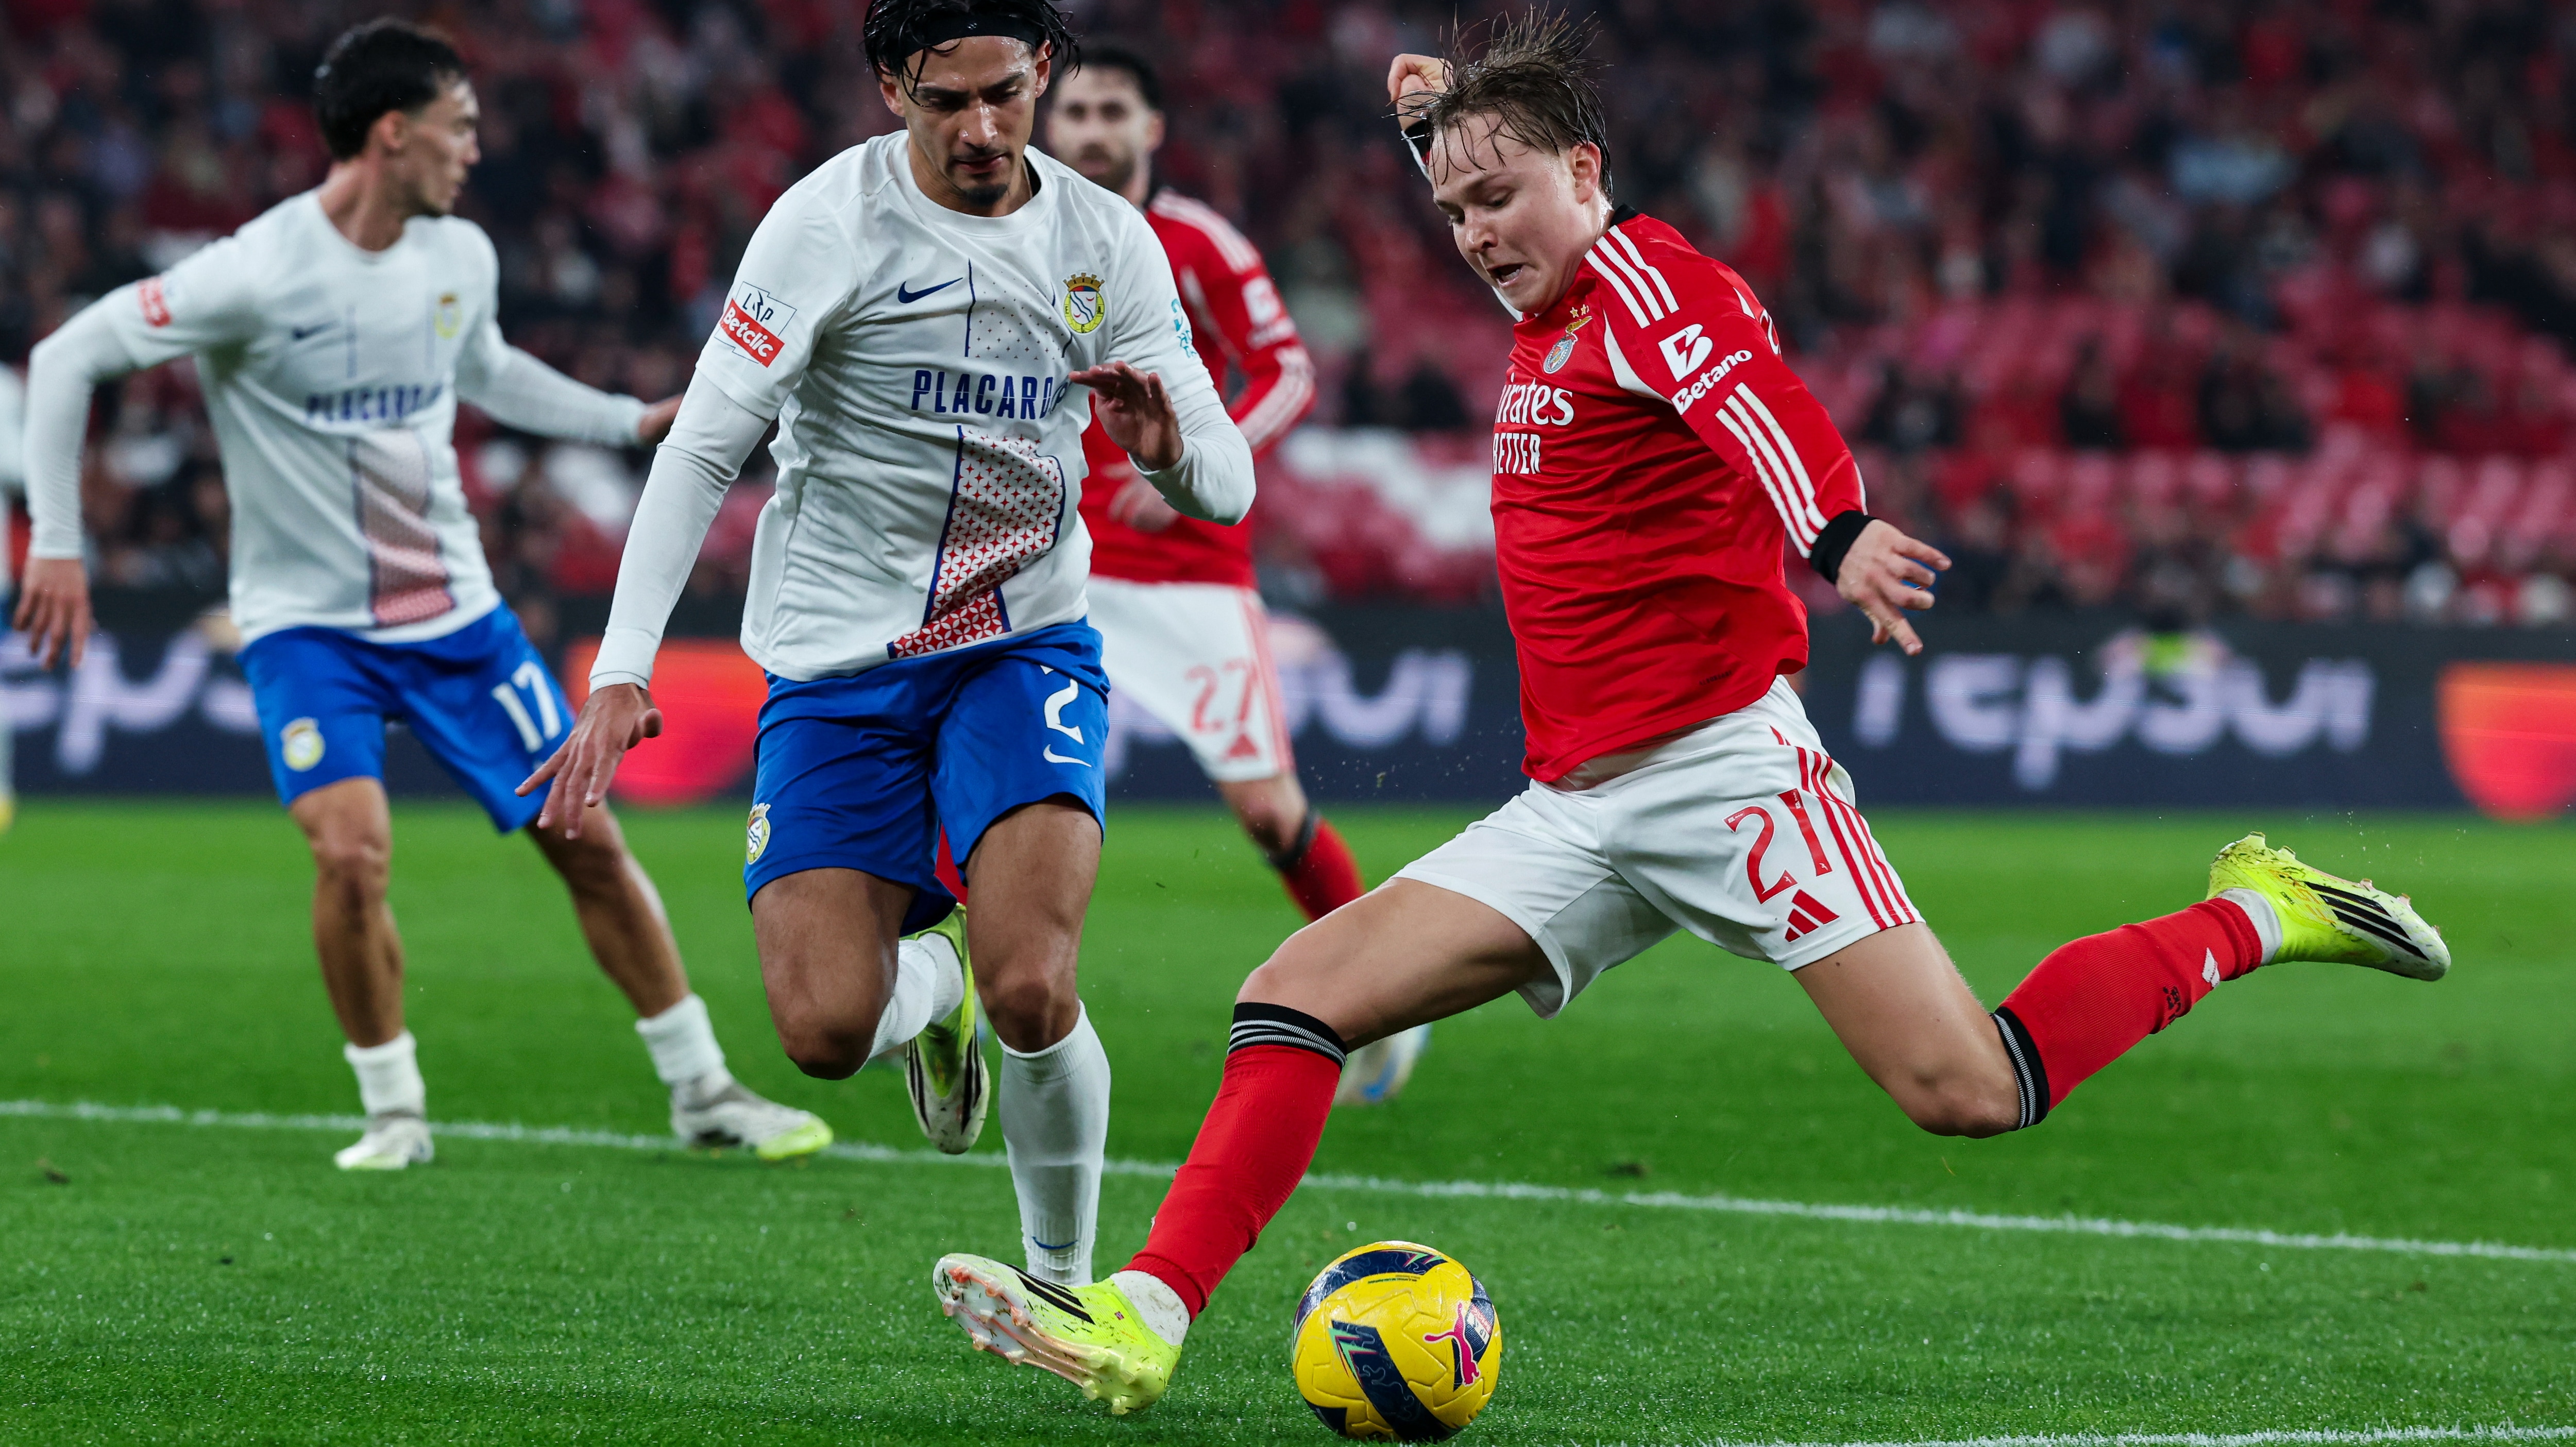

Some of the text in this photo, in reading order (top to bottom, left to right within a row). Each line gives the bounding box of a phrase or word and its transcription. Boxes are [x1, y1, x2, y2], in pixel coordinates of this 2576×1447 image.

[723, 307, 773, 357] Betclic
[1495, 372, 1574, 425] irates
[1671, 349, 1753, 415] Betano
[1493, 432, 1541, 474] BETTER
[492, 661, 562, 753] 17
[1040, 665, 1084, 745] 2
[1187, 656, 1259, 734] 27
[1722, 788, 1833, 905] 21
